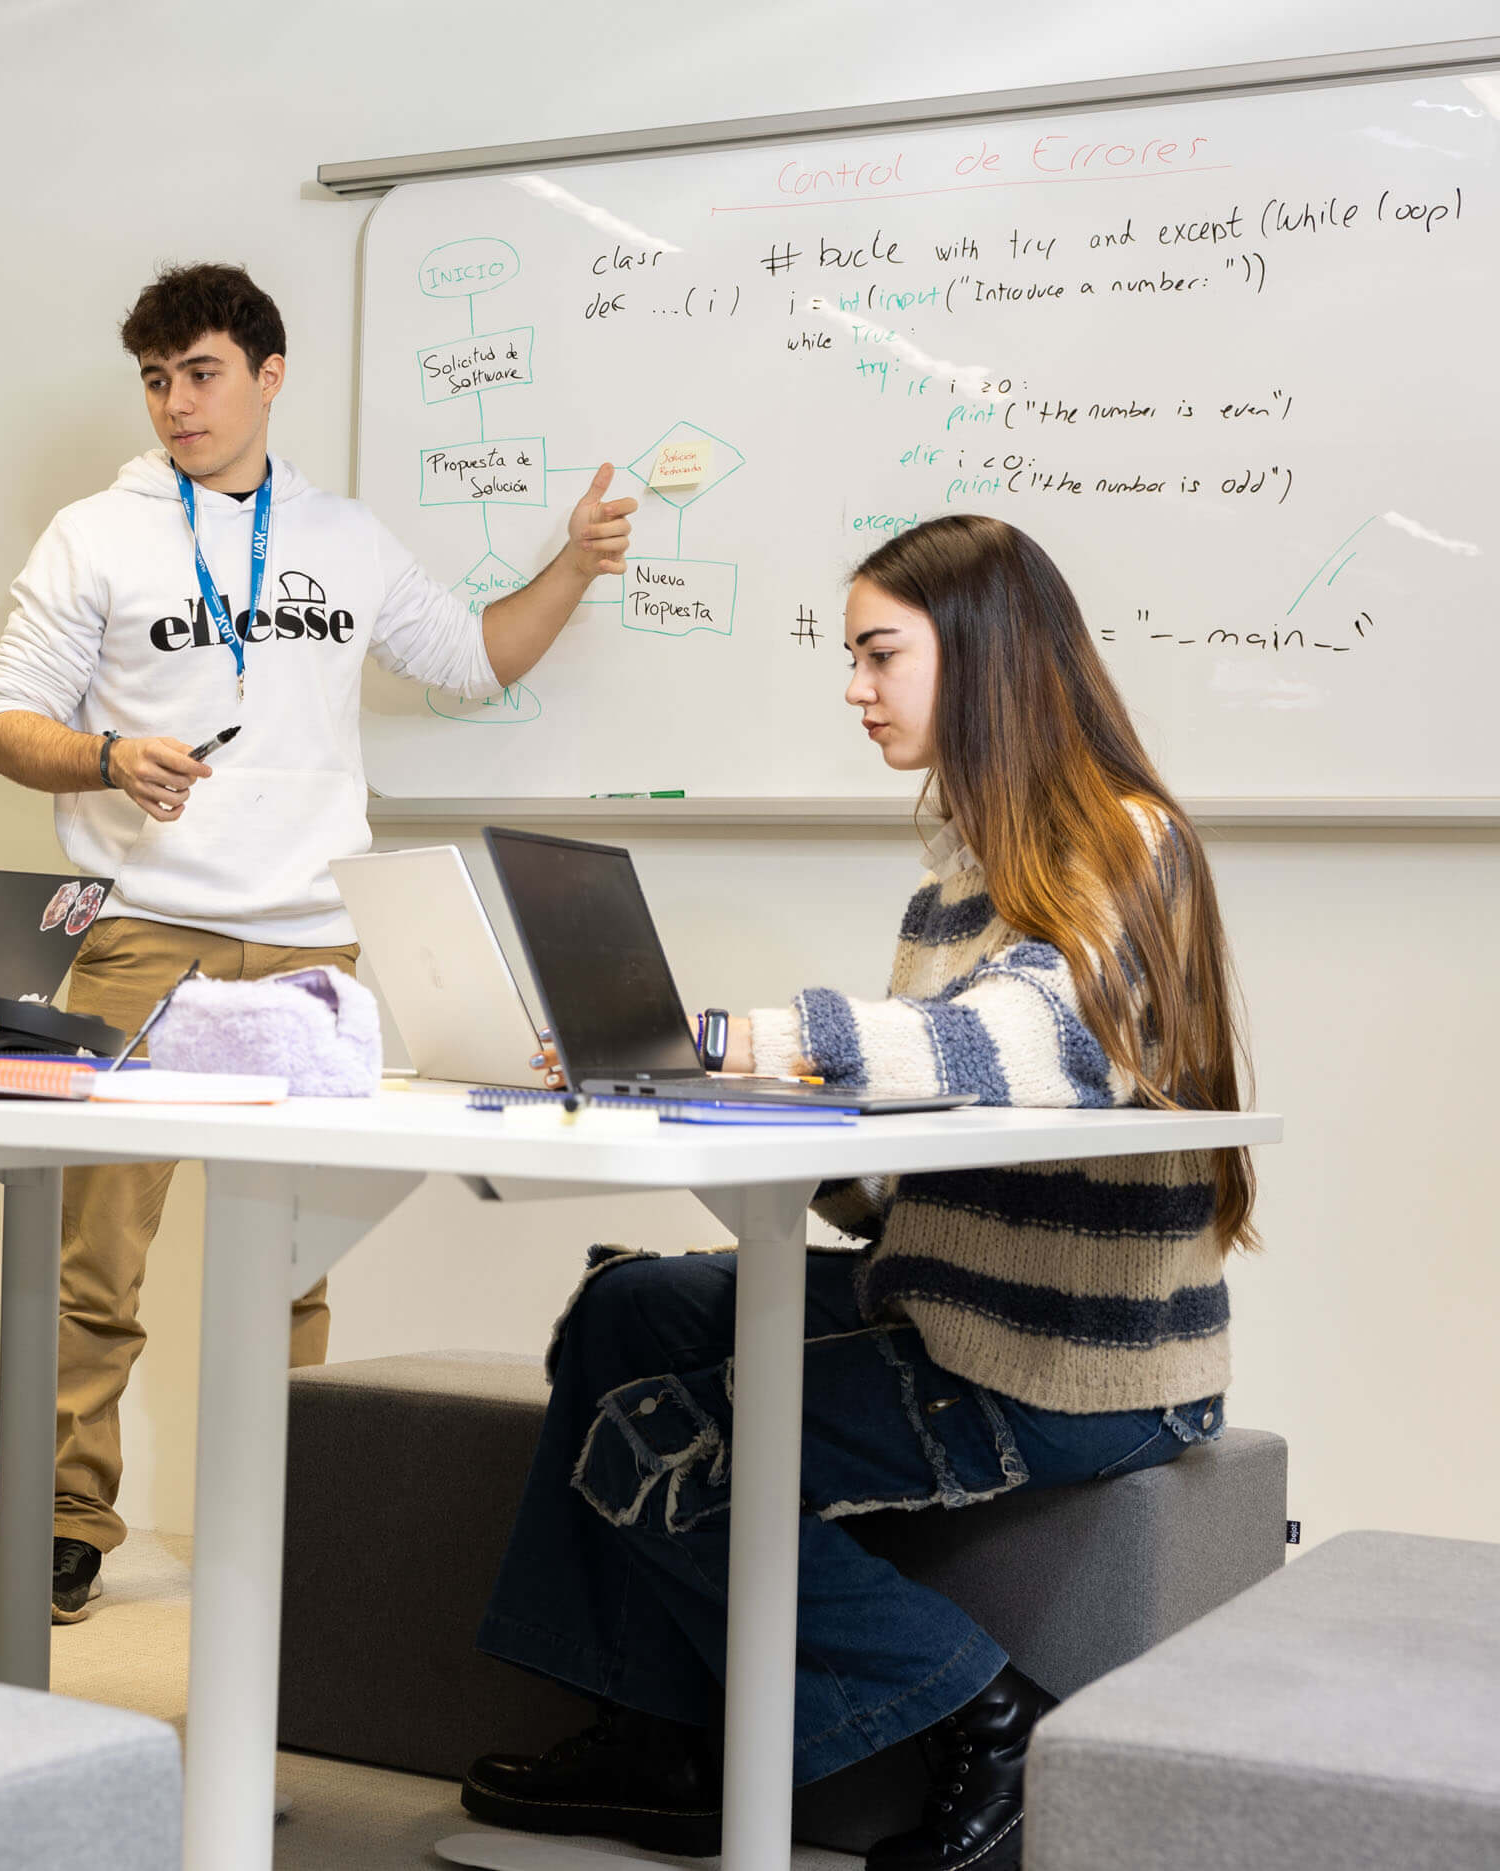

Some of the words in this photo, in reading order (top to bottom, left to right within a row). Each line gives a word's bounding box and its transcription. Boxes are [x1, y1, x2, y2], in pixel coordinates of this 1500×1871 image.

[776, 151, 904, 198] Control
[956, 145, 1001, 175] de
[819, 229, 904, 267] bucle
[935, 236, 979, 261] with
[1010, 228, 1056, 260] try
[1089, 218, 1136, 250] and
[1158, 205, 1244, 246] except
[426, 262, 505, 289] INICIO
[1080, 282, 1094, 295] a
[787, 332, 832, 352] while
[422, 346, 496, 379] Solicitud
[505, 345, 518, 361] de
[1088, 401, 1156, 422] number
[1177, 399, 1194, 418] is
[426, 447, 507, 477] Propuesta
[517, 449, 533, 467] de
[470, 475, 529, 499] Solución
[1181, 476, 1201, 494] is
[253, 530, 268, 561] UAX
[635, 564, 686, 588] Nueva
[629, 590, 714, 625] Propuesta
[149, 594, 355, 652] ellesse
[214, 612, 237, 646] UAX
